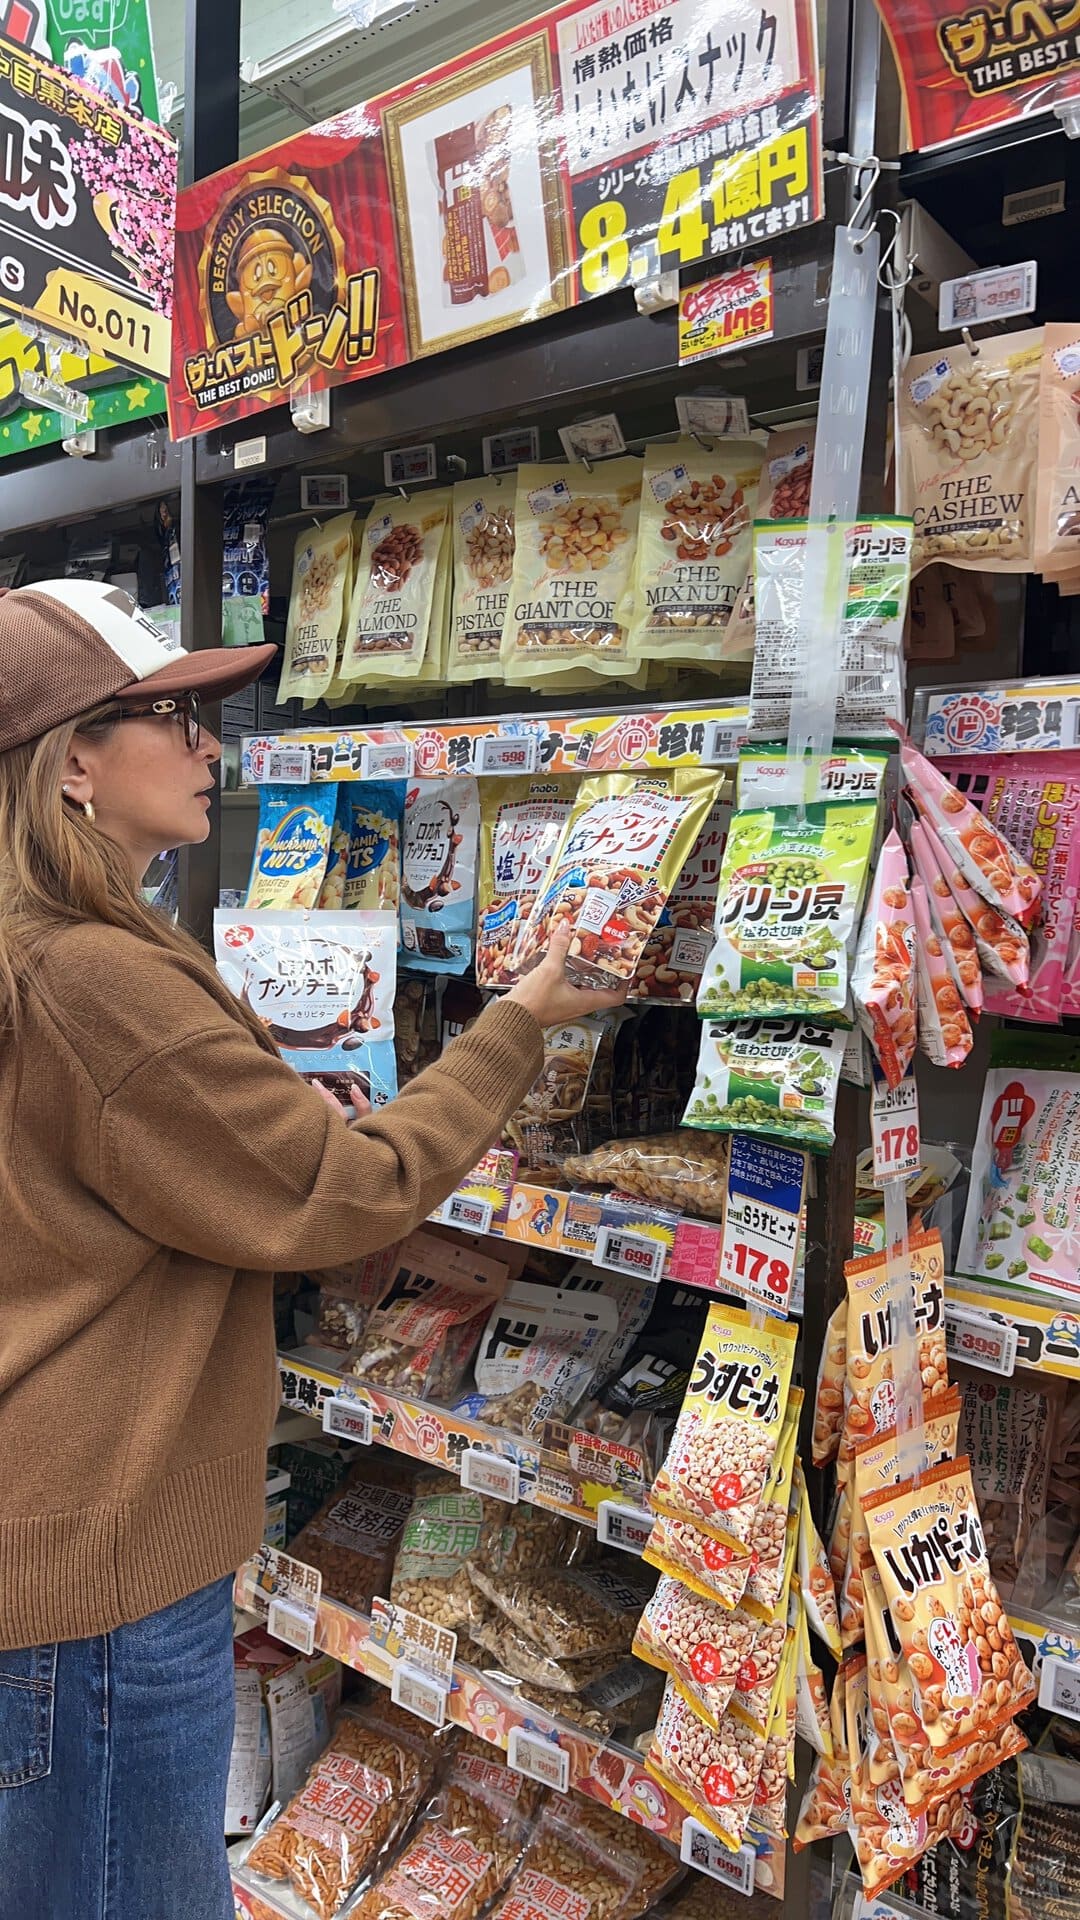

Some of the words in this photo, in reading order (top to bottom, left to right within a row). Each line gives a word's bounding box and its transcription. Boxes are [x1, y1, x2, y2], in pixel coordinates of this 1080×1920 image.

[572, 16, 675, 84] 情熱価格
[973, 59, 1013, 86] THE
[1019, 43, 1068, 70] BEST
[710, 195, 809, 254] 売れてます!
[211, 214, 245, 294] BESTBUY
[248, 194, 324, 257] SELECTION
[58, 285, 151, 355] No.011
[198, 391, 217, 404] THE
[218, 381, 240, 397] BEST
[243, 367, 275, 387] DON!!
[940, 474, 992, 500] THE
[912, 493, 1025, 527] CASHEW
[673, 566, 720, 583] THE
[549, 581, 598, 598] THE
[645, 586, 684, 606] MIX
[373, 598, 402, 615] THE
[475, 594, 509, 611] THE
[514, 602, 573, 621] GIANT
[355, 613, 418, 633] ALMOND
[502, 751, 526, 763] 598
[530, 785, 559, 793] inaba
[416, 820, 443, 841] ロカボ
[263, 851, 313, 870] NUTS
[405, 843, 444, 862] ナッツチョコ
[744, 925, 804, 937] 塩わさび味
[281, 1011, 334, 1019] すっきりビター
[881, 1124, 918, 1163] 178
[905, 1157, 918, 1168] 193
[464, 1208, 483, 1223] 599
[625, 1248, 653, 1267] 699
[734, 1243, 790, 1294] 178
[762, 1289, 783, 1305] 193
[960, 1332, 1001, 1357] 399
[689, 1351, 778, 1420] うすピーナ
[331, 1500, 404, 1538] 業務用
[402, 1523, 480, 1554] 業務用
[276, 1555, 320, 1594] 業務用
[404, 1616, 456, 1661] 業務用
[321, 1755, 394, 1799] 工場直送
[303, 1777, 377, 1832] 業務用
[400, 1848, 473, 1904] 業務用
[716, 1858, 743, 1878] 699
